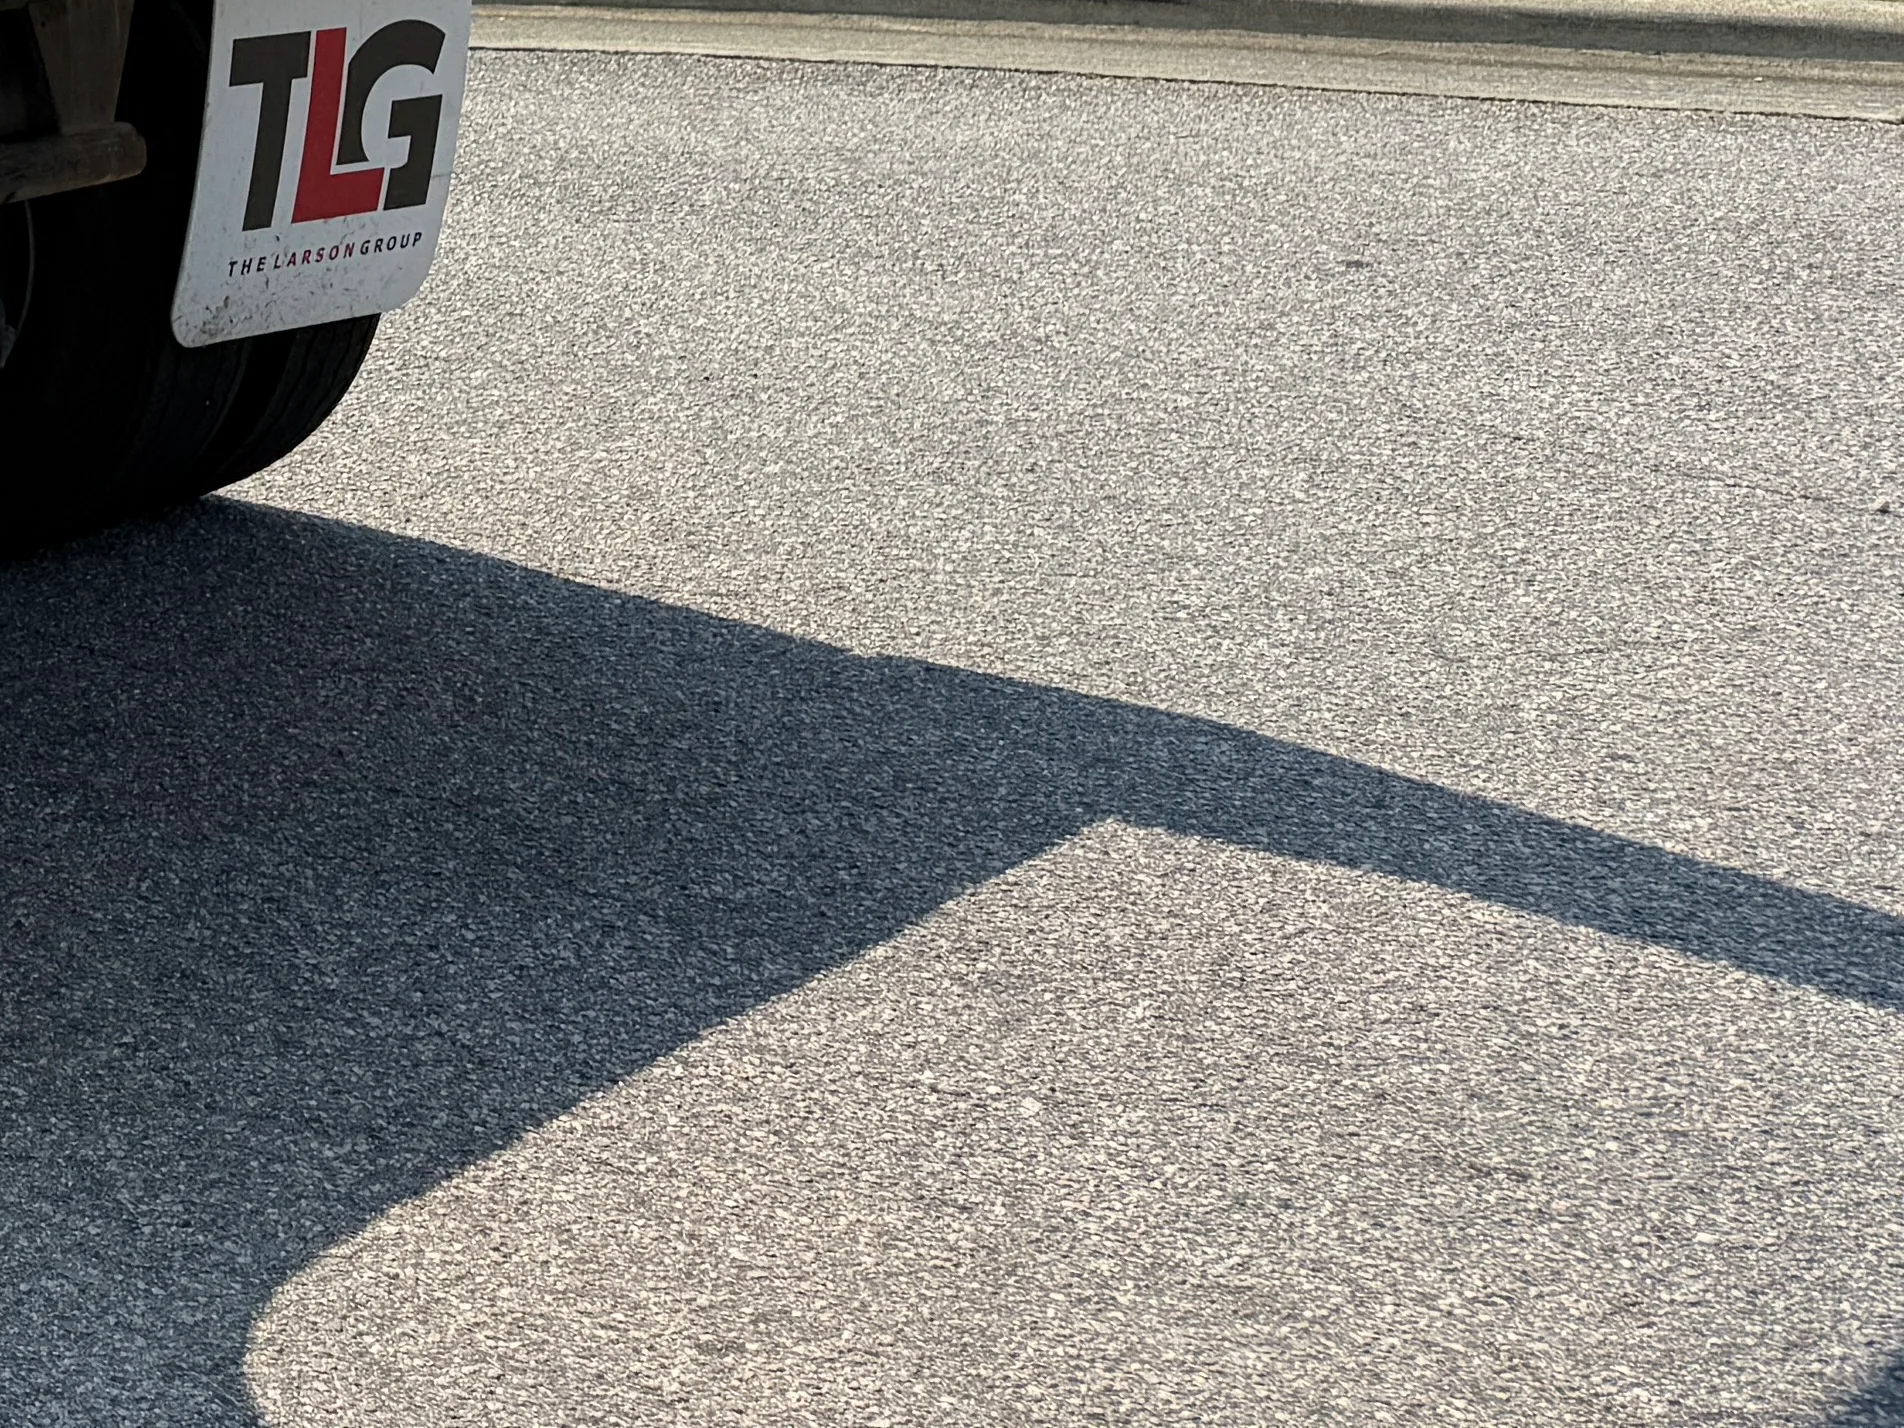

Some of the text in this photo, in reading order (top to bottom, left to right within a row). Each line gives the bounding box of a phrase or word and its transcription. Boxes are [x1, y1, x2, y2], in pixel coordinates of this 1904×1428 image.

[228, 18, 446, 232] TLG
[227, 231, 424, 278] THE LARSON GROUP
